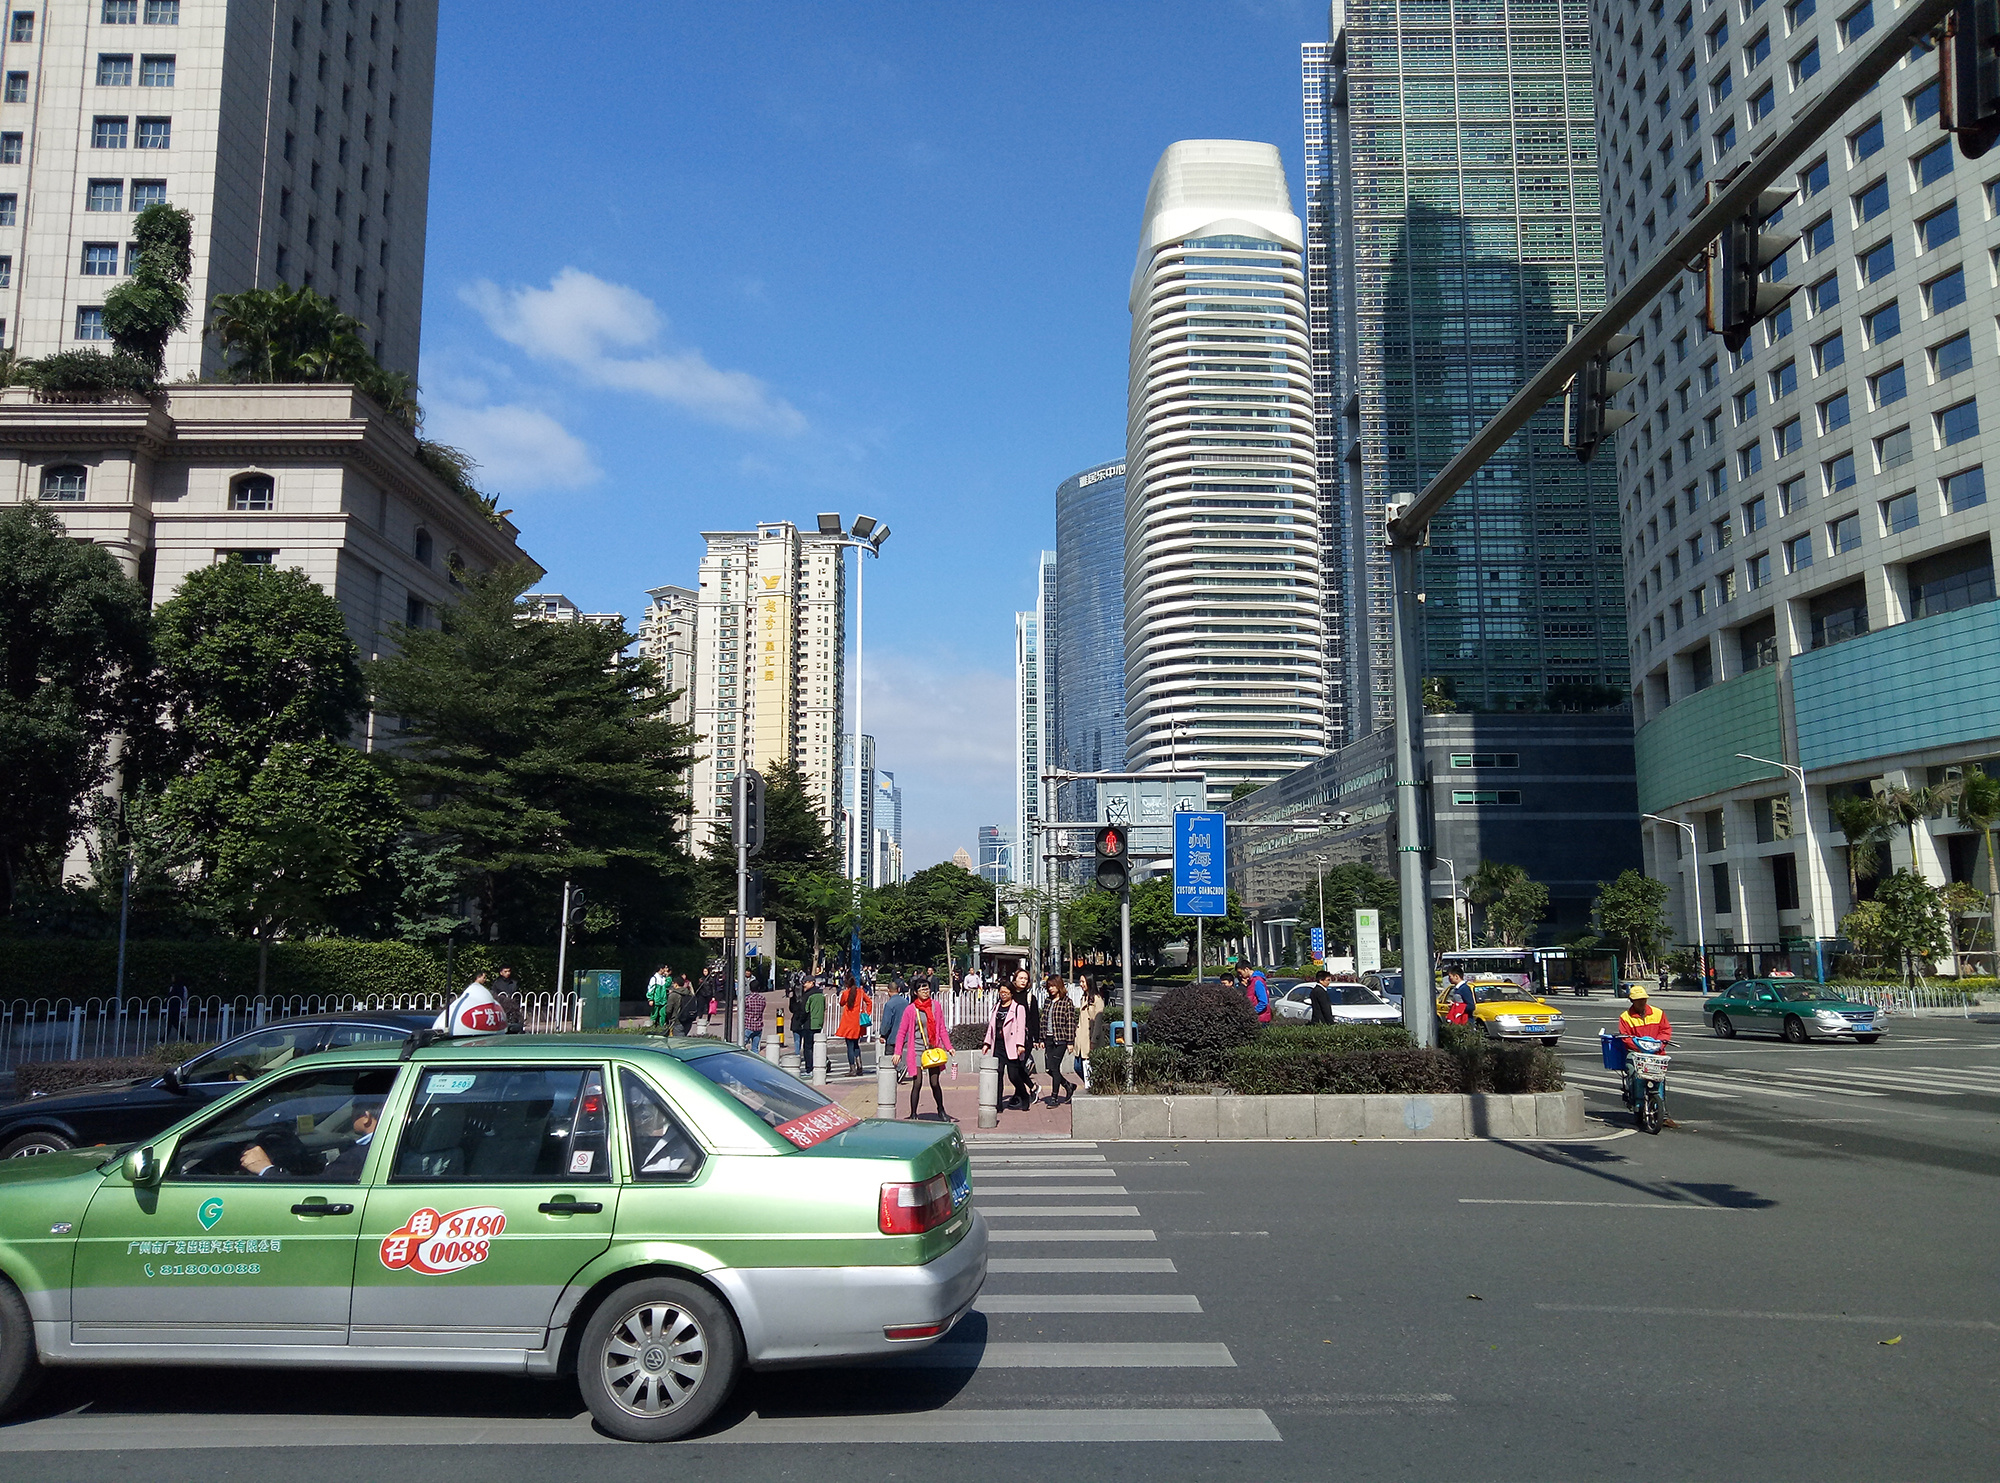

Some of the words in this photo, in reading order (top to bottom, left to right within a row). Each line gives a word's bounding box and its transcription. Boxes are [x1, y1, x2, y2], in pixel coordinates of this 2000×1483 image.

[1187, 815, 1213, 885] 广州海关
[1176, 885, 1197, 895] CUSTOMS
[471, 1008, 497, 1028] 广发
[446, 1214, 506, 1239] 8180
[127, 1239, 282, 1255] 广州市广发出租汽车有限公司
[429, 1241, 489, 1264] 0088
[159, 1263, 262, 1276] 81800088
